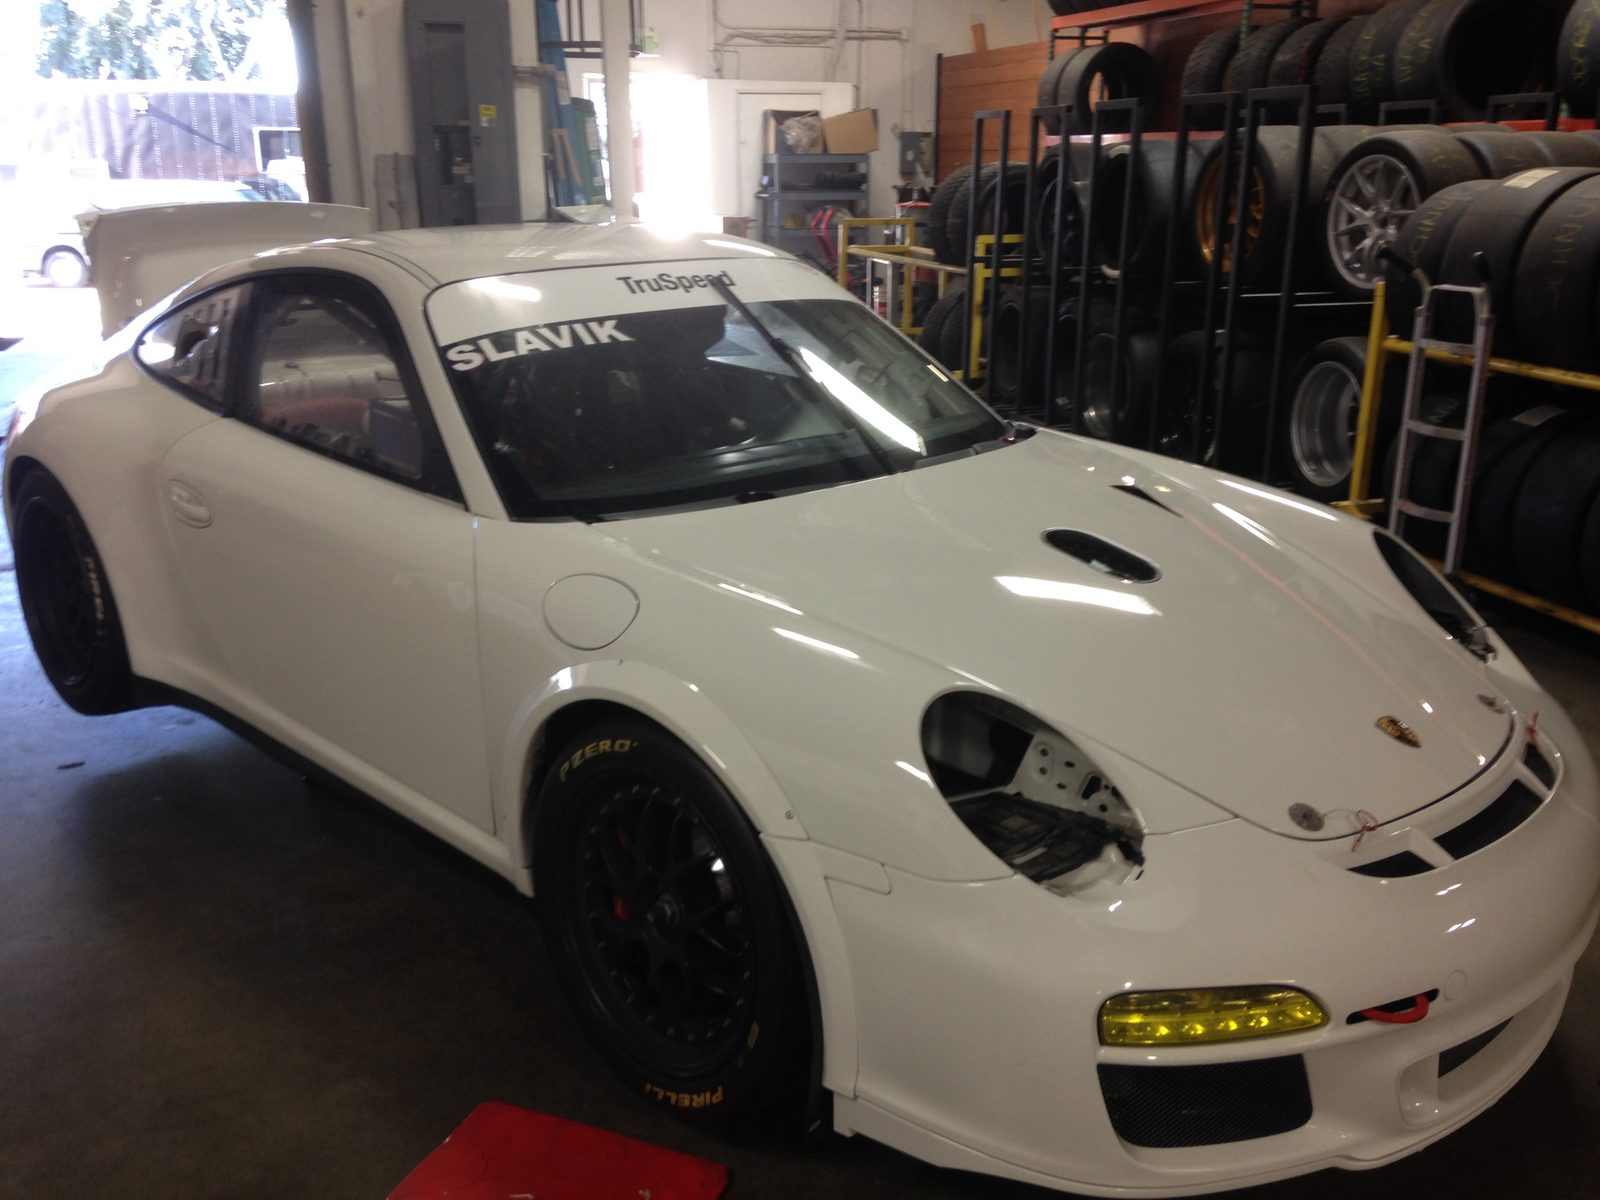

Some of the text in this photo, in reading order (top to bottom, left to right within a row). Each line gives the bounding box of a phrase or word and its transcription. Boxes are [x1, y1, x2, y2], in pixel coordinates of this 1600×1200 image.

[615, 270, 737, 294] TruSped
[445, 318, 635, 372] SLAVIK
[643, 1081, 725, 1109] PIRELLI
